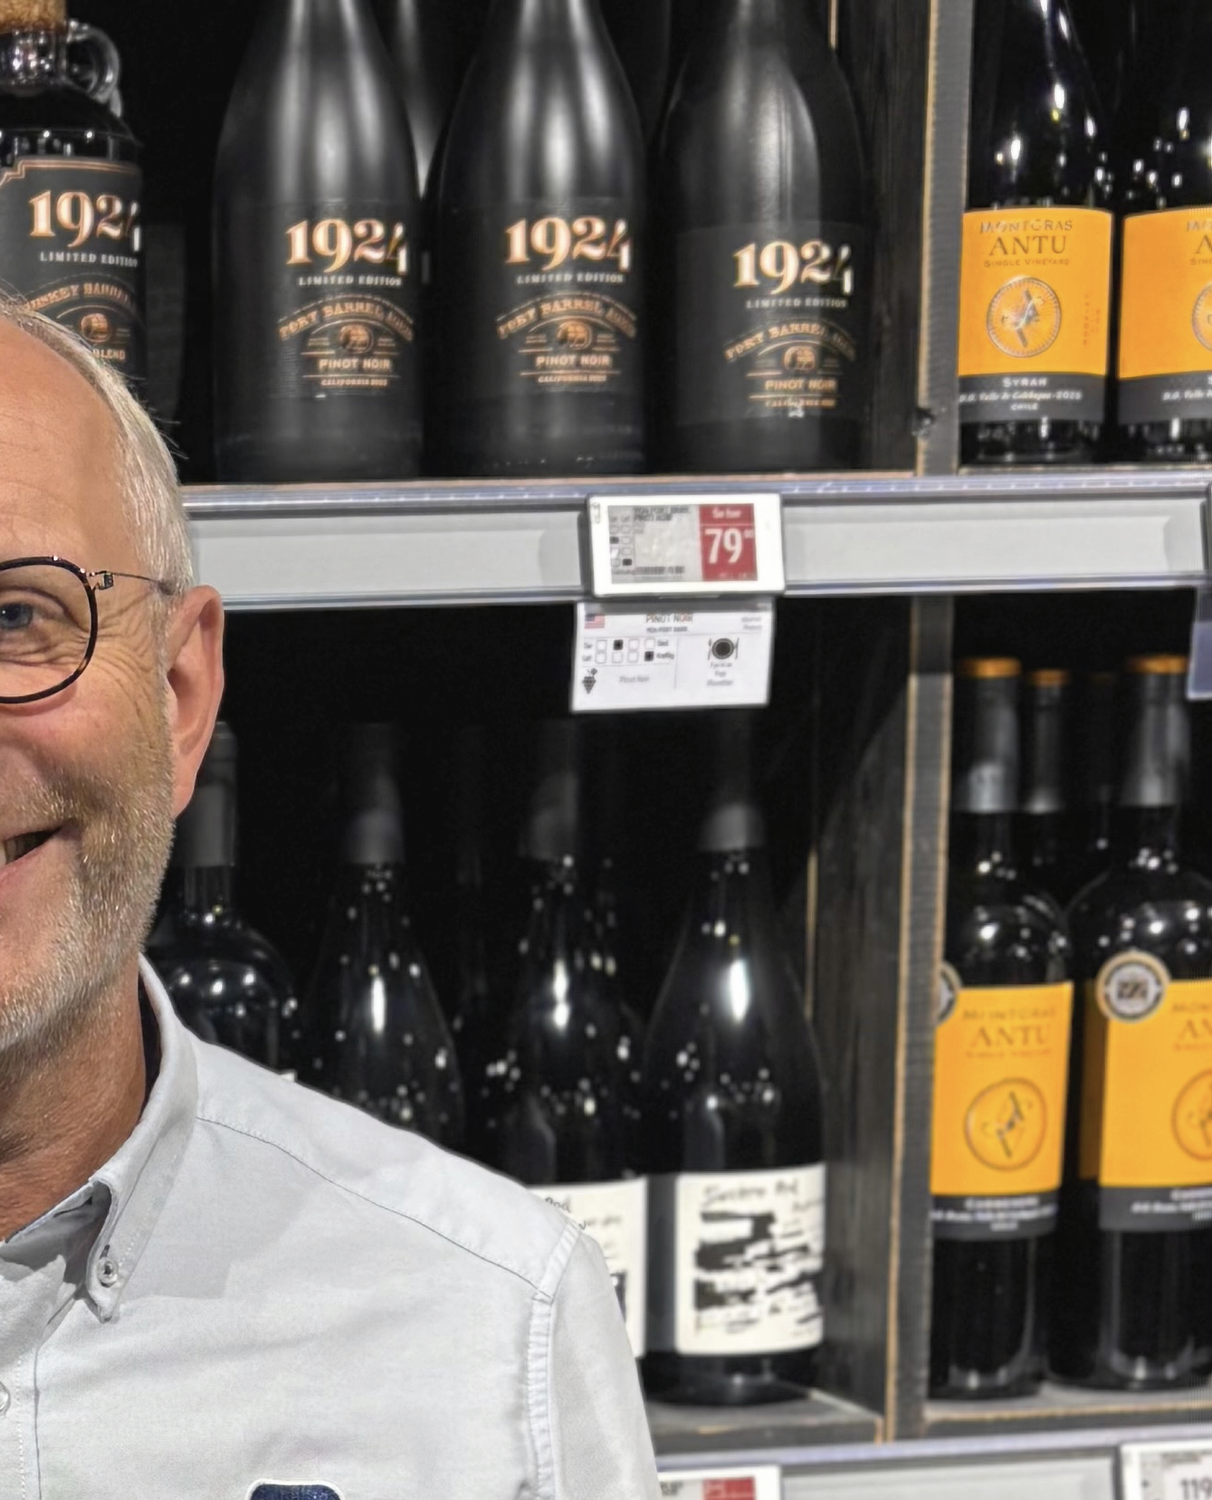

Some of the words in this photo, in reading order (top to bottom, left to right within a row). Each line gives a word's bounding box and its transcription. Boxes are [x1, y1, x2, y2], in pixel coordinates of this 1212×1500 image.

[29, 189, 142, 252] 1924
[980, 219, 1073, 233] MONTGRAS
[286, 218, 408, 274] 1924
[505, 216, 632, 272] 1924
[989, 235, 1067, 256] ANTU
[40, 251, 96, 263] LIMITED
[734, 240, 853, 294] 1924
[298, 275, 354, 286] LIMITED
[359, 275, 402, 286] EDITION
[517, 273, 573, 284] LIMITED
[577, 273, 623, 283] EDITION
[322, 301, 384, 319] BARREL
[541, 298, 604, 316] BARREL
[747, 297, 801, 309] LIMITED
[805, 298, 847, 308] EDITION
[768, 323, 828, 339] BARREL
[318, 358, 359, 370] PINOT
[362, 358, 391, 370] NOIR
[536, 355, 576, 366] PINOT
[580, 355, 610, 366] NOIR
[765, 379, 804, 391] PINOT
[808, 379, 836, 390] NOIR
[1003, 377, 1047, 388] SYRAH
[704, 528, 743, 564] 79
[971, 1024, 1050, 1047] ANTU
